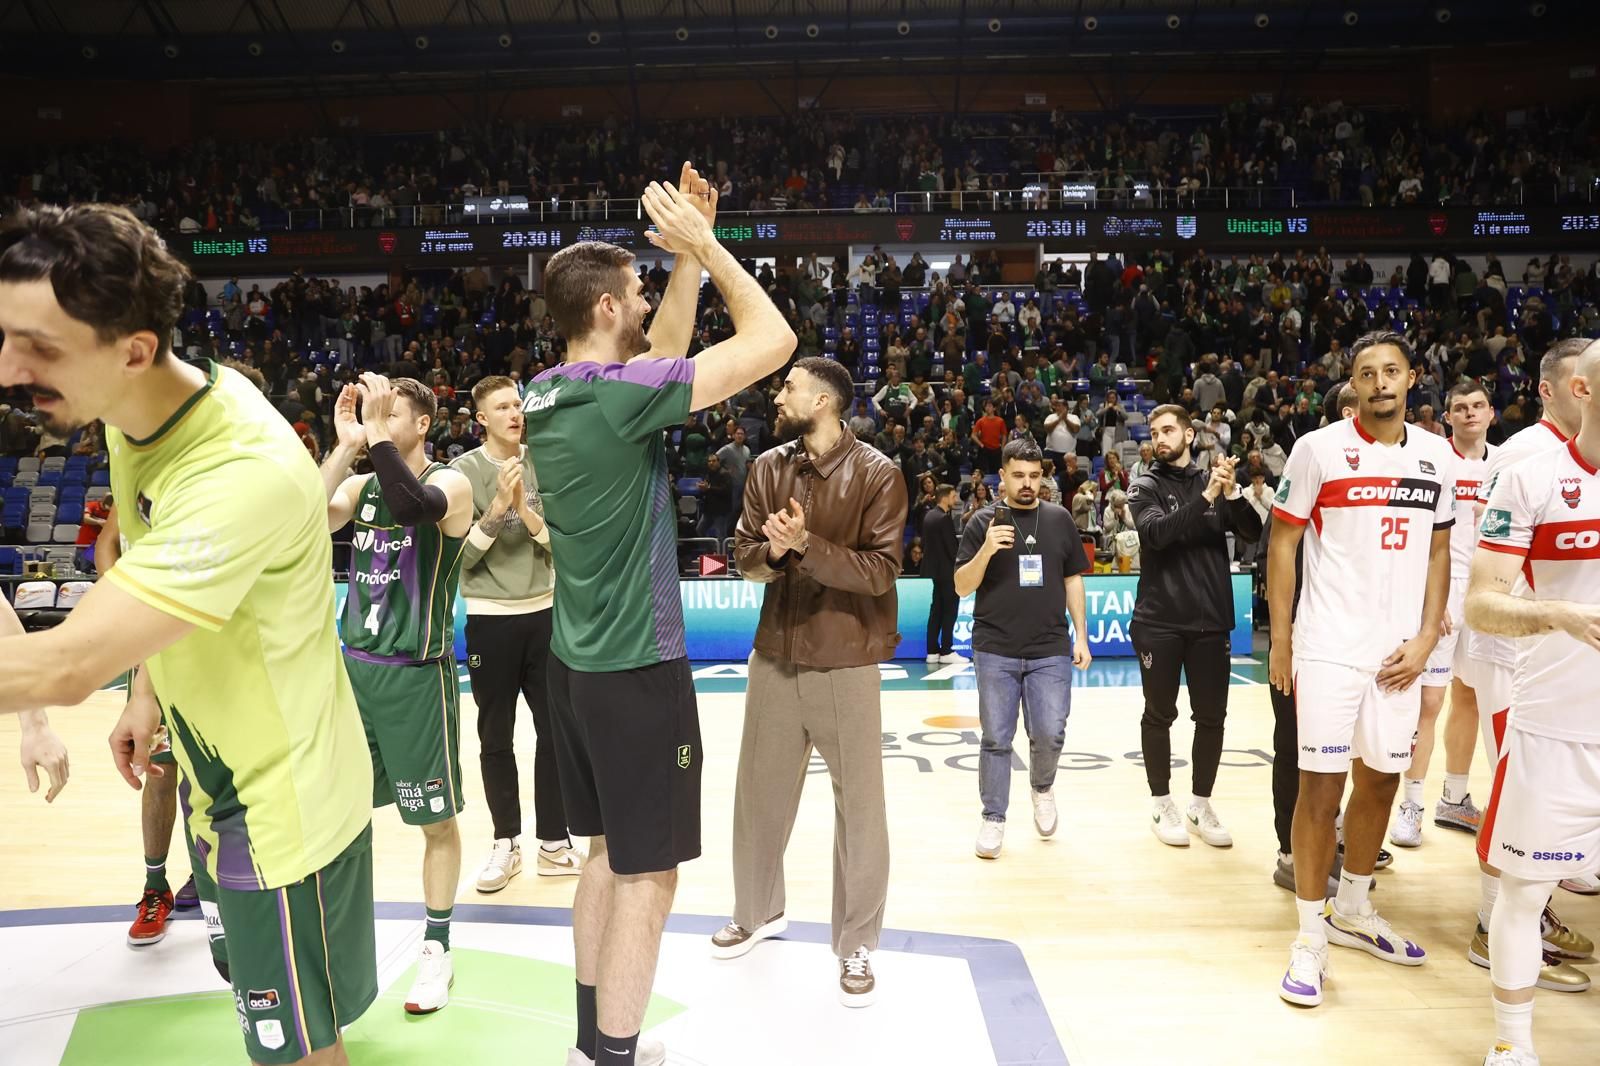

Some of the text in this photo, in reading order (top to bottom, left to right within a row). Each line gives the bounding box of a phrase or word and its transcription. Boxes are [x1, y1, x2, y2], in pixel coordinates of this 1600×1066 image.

[1026, 220, 1072, 236] 20:30
[1076, 219, 1087, 236] H
[1227, 218, 1283, 235] Unicaja
[1287, 217, 1308, 233] VS
[1473, 224, 1530, 235] 21 de enero
[1561, 215, 1600, 230] 20:3
[502, 231, 561, 247] 20:30 H
[756, 224, 777, 238] VS
[940, 230, 996, 240] 21 de enero
[192, 239, 245, 256] Unicaja
[248, 238, 268, 253] VS
[420, 242, 474, 252] 21 de enero
[1380, 516, 1410, 551] 25
[1555, 529, 1600, 551] CO
[363, 603, 381, 636] 4
[1301, 744, 1317, 753] vive
[1502, 842, 1527, 858] vive
[250, 998, 272, 1008] acb
